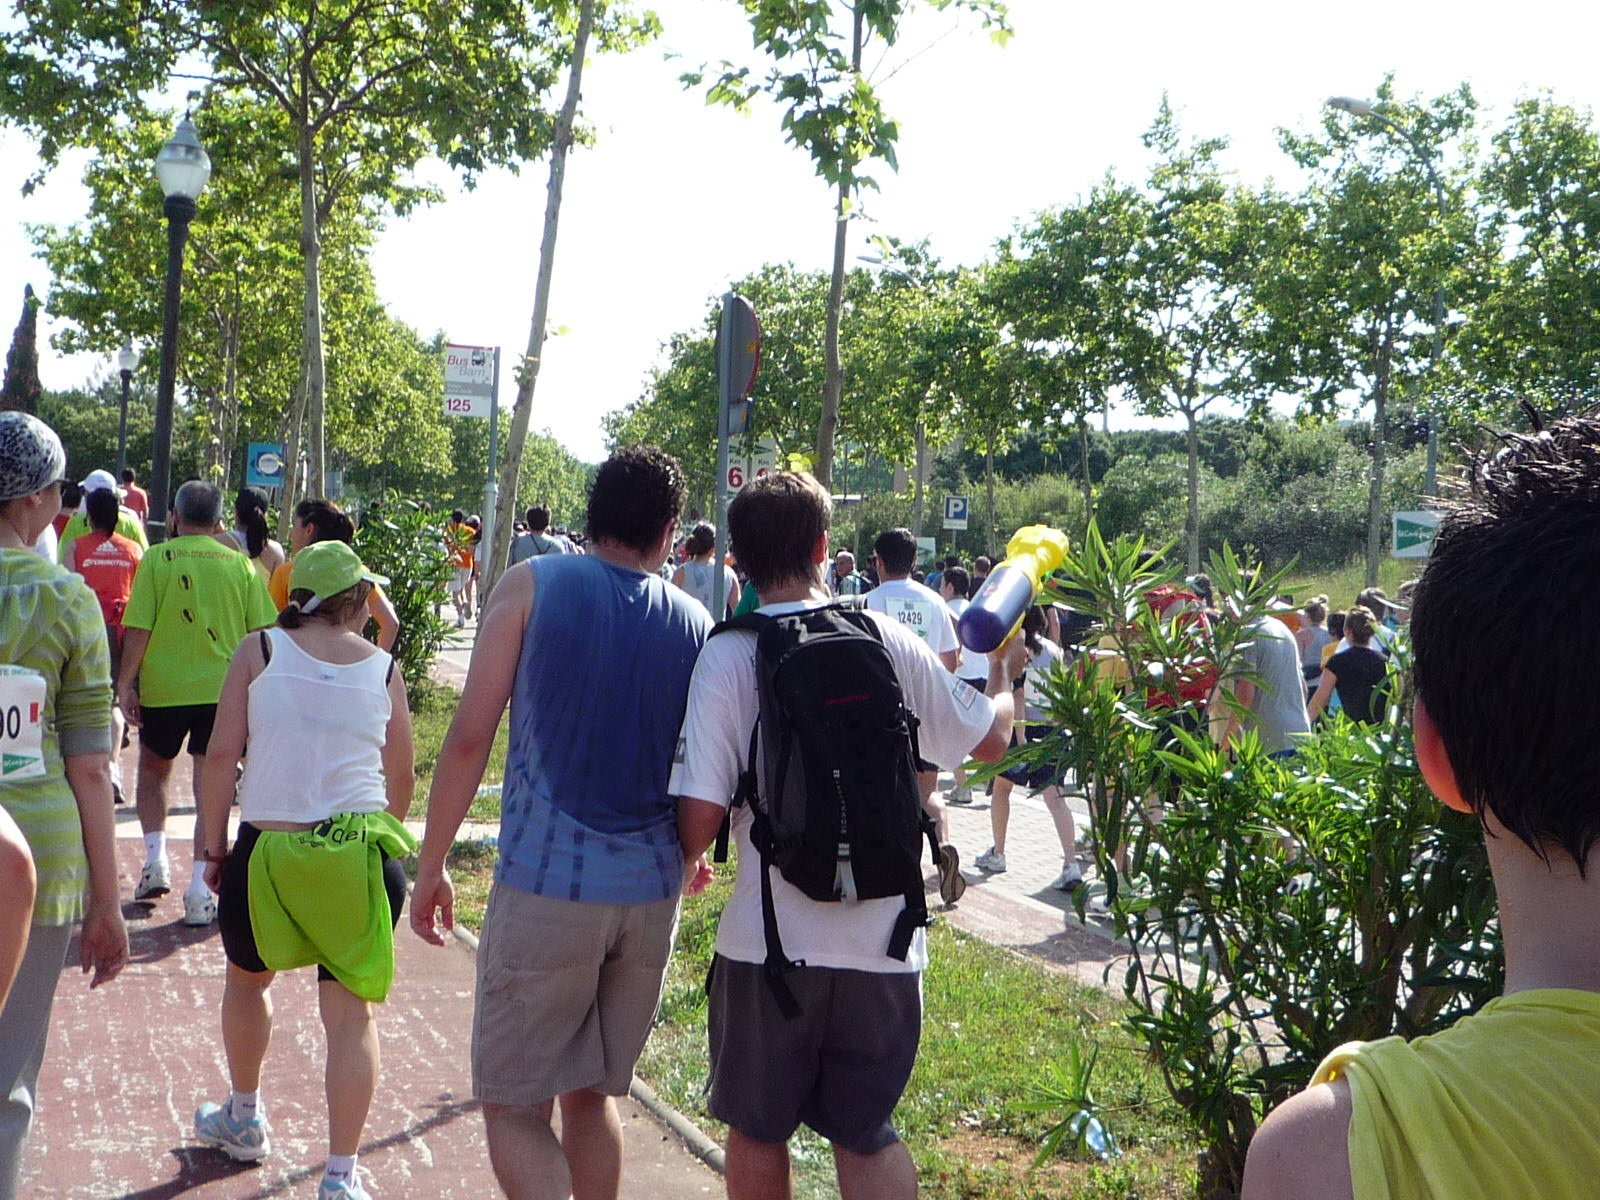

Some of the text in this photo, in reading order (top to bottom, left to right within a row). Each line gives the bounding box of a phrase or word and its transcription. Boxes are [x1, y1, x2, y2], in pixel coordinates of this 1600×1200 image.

[447, 354, 469, 366] Bus
[446, 398, 471, 412] 125
[728, 466, 743, 488] 6
[948, 498, 964, 518] P
[898, 611, 923, 625] 12429
